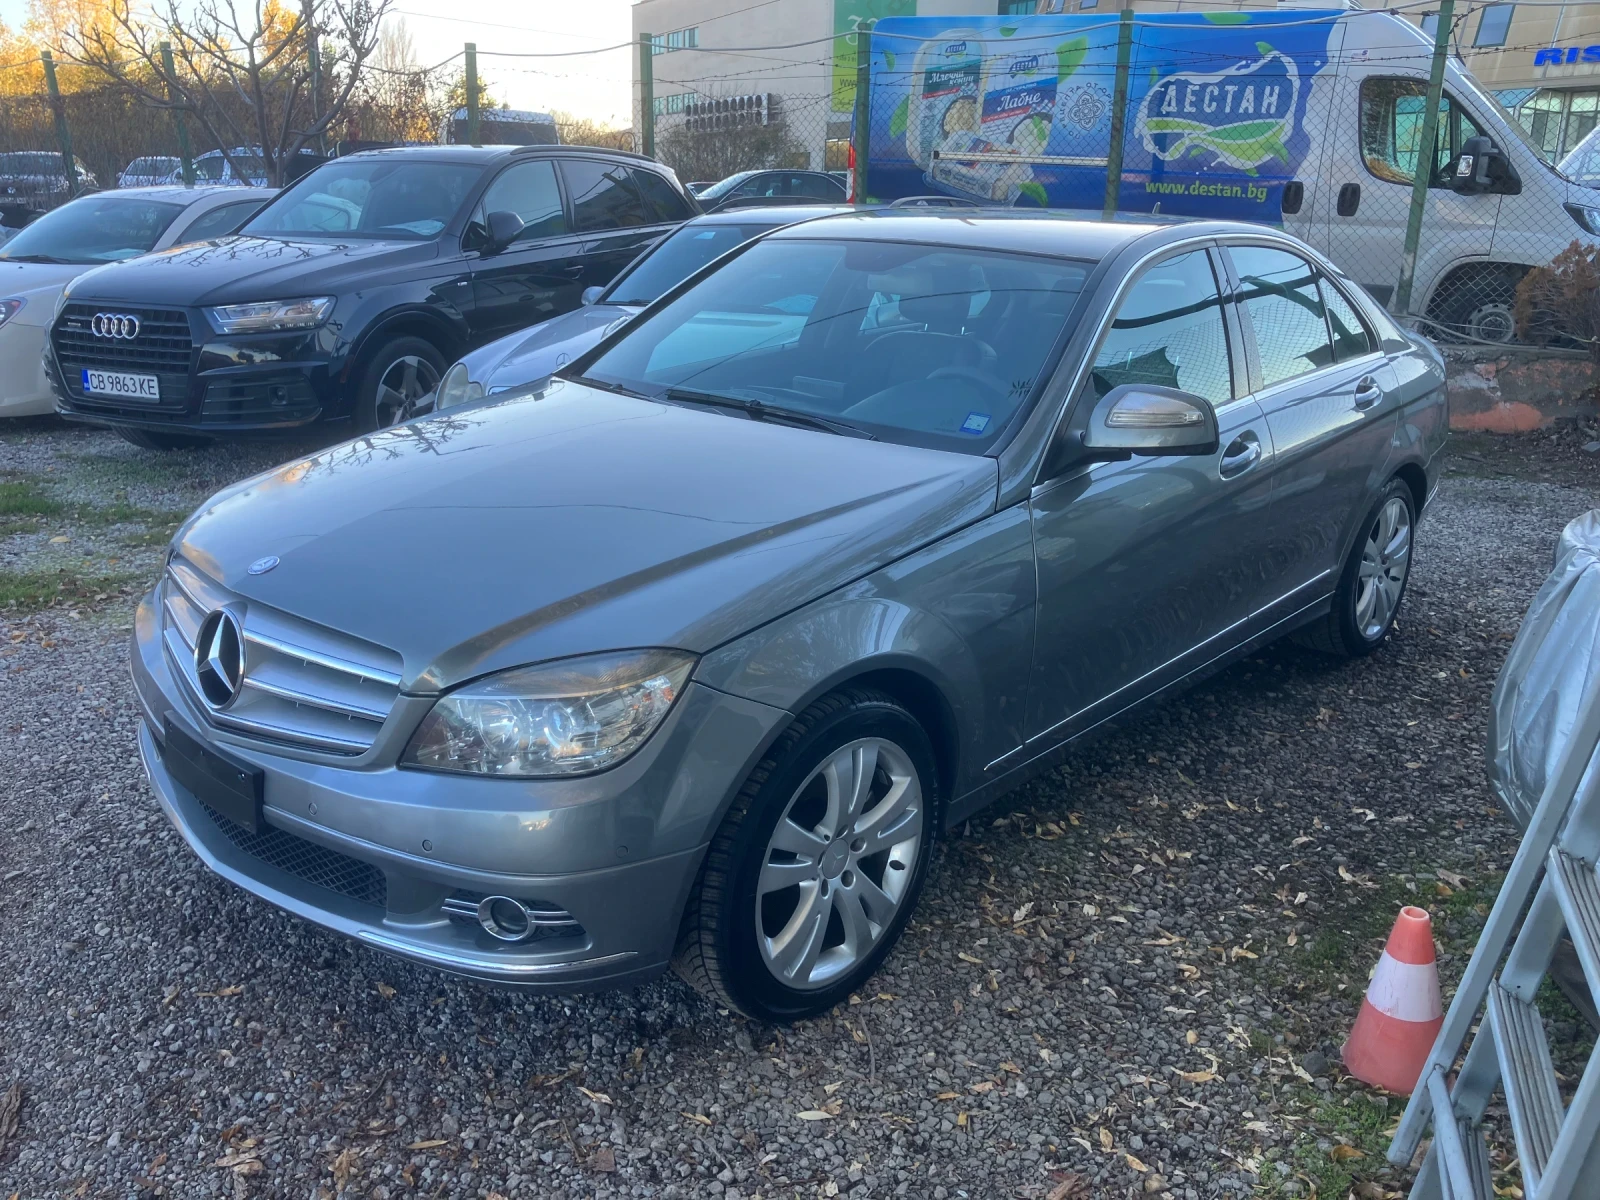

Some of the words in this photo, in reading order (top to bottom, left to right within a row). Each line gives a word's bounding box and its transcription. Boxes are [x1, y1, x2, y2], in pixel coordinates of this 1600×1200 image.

[1011, 60, 1037, 71] ДЕСТАН
[997, 92, 1042, 112] Лабне
[1161, 85, 1280, 114] ДЕСТАН
[1145, 180, 1268, 202] www.destan.bg
